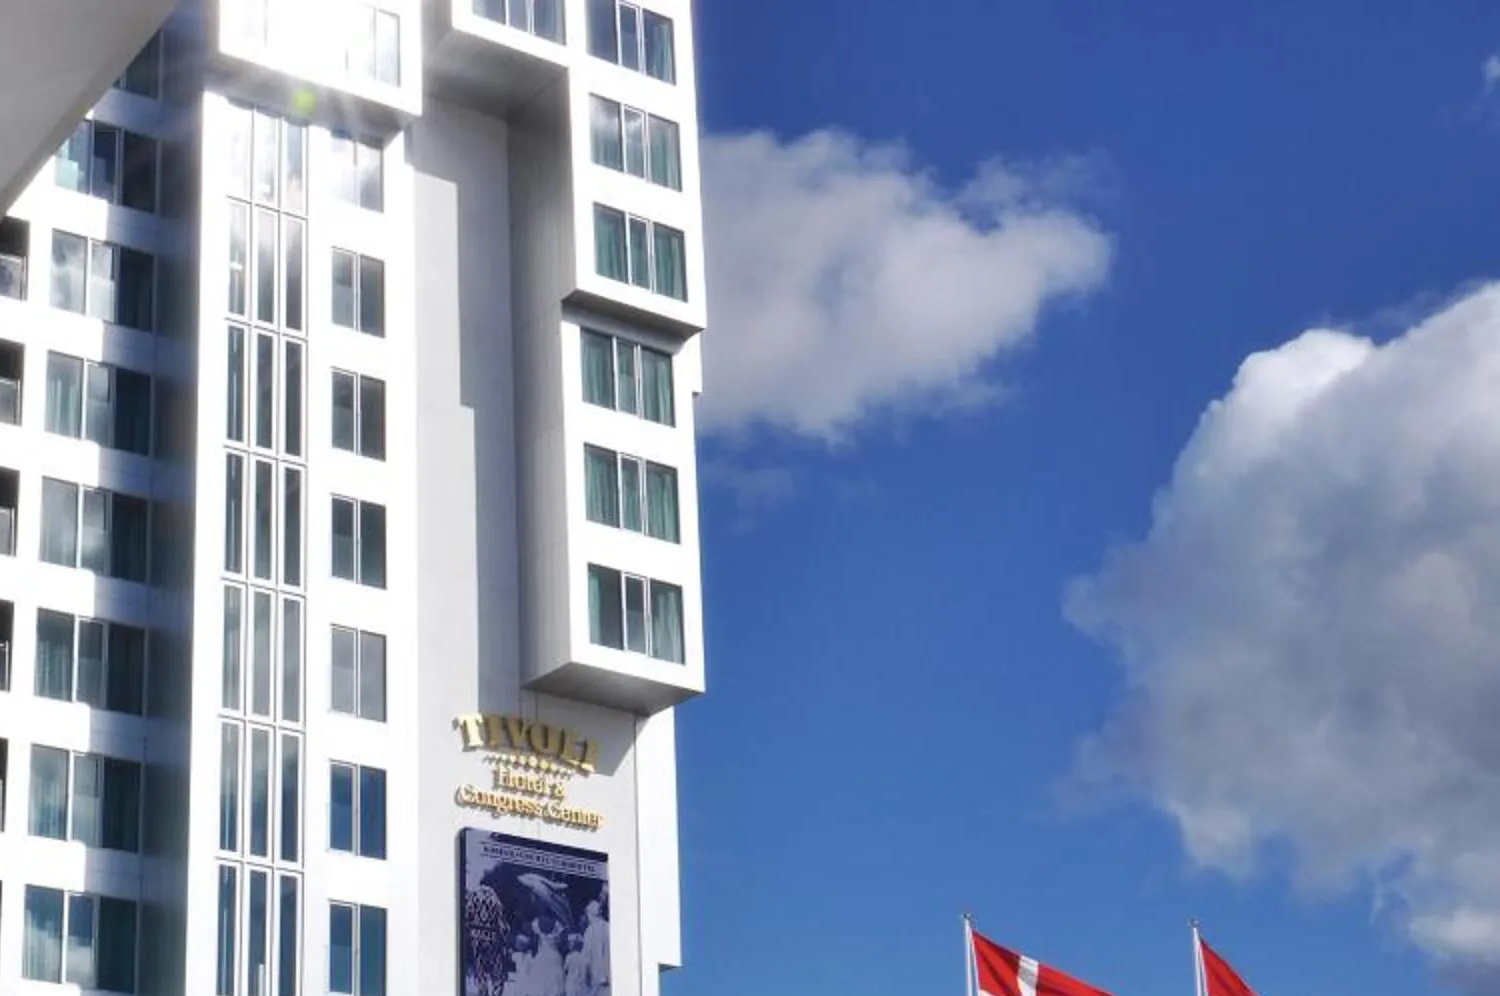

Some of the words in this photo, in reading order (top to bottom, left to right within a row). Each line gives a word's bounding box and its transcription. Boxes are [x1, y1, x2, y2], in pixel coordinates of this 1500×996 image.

[454, 713, 598, 773] TIVOLI
[496, 767, 550, 793] Hotel
[457, 783, 543, 816] Congress
[545, 802, 605, 830] Center
